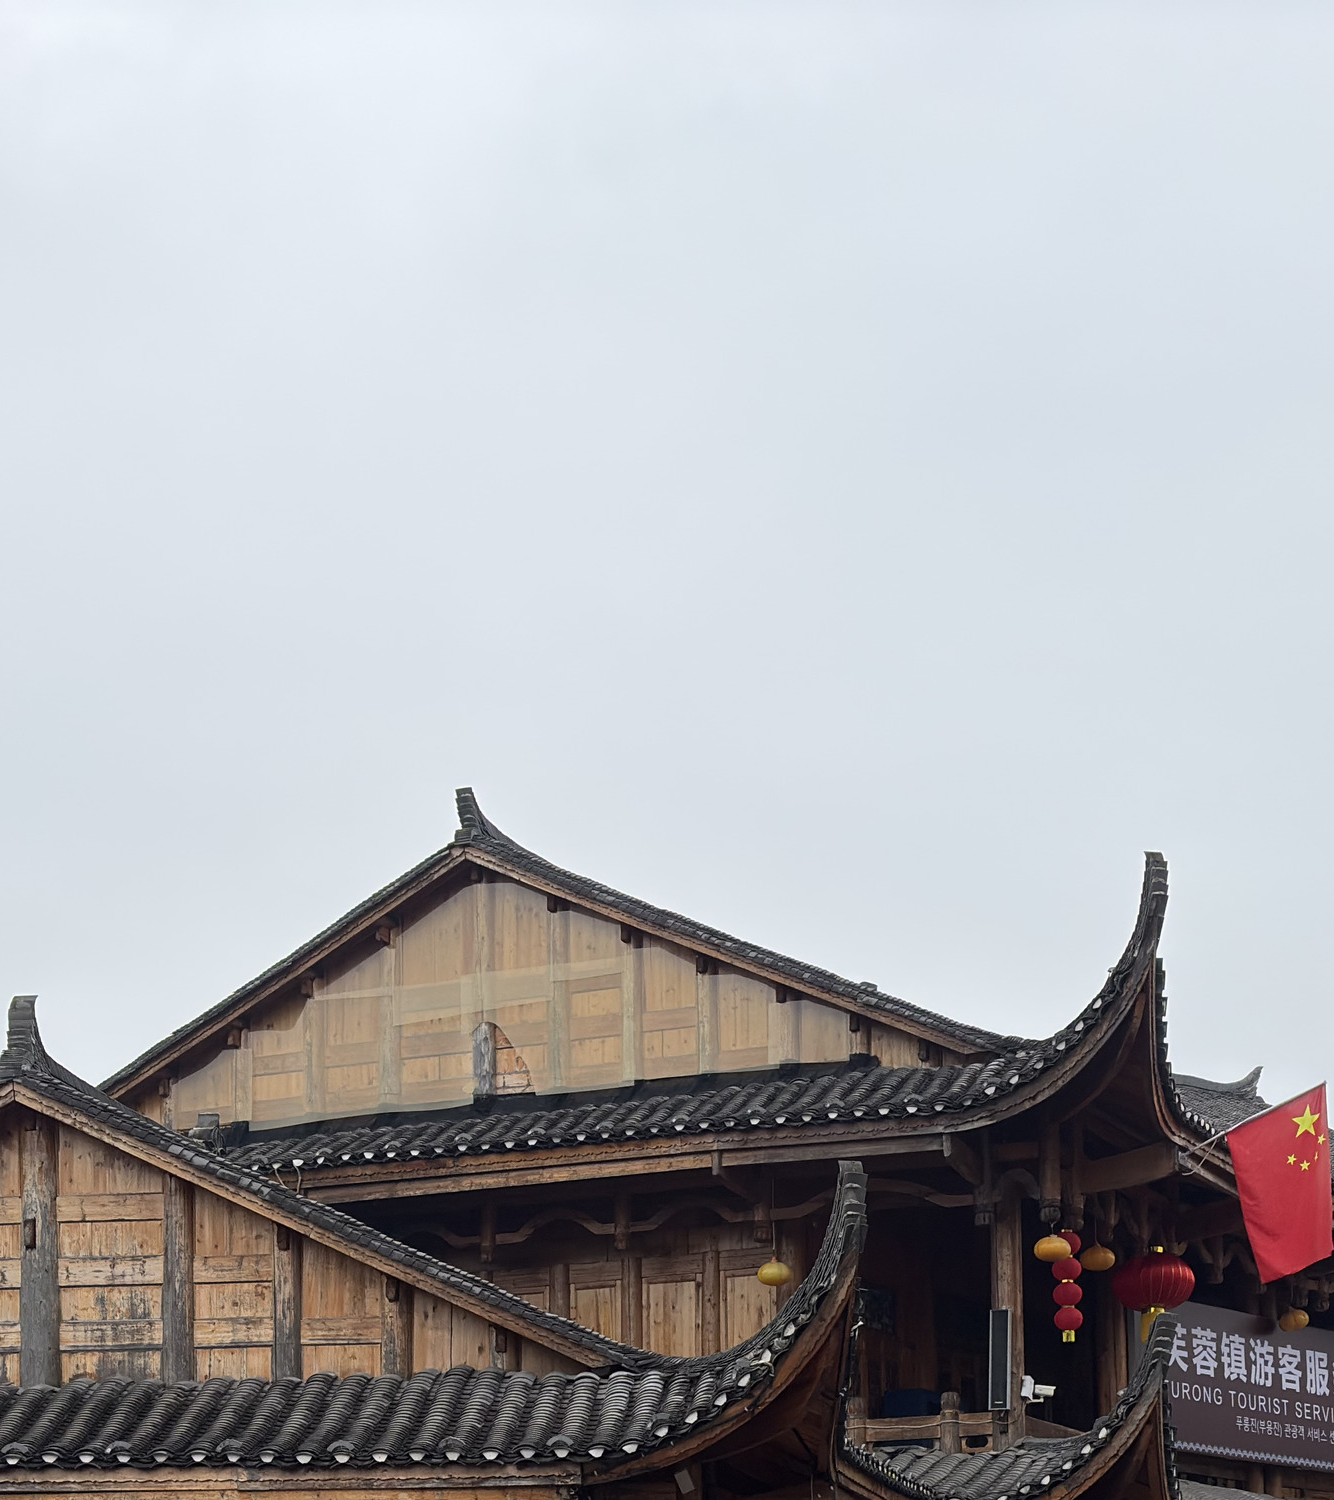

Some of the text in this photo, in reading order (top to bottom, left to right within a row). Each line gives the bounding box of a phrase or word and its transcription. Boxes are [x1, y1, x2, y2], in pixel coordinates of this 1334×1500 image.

[1164, 1379, 1223, 1406] URONG
[1228, 1390, 1289, 1417] TOURIST
[1284, 1423, 1305, 1441] 관광객
[1306, 1427, 1328, 1443] 서비스
